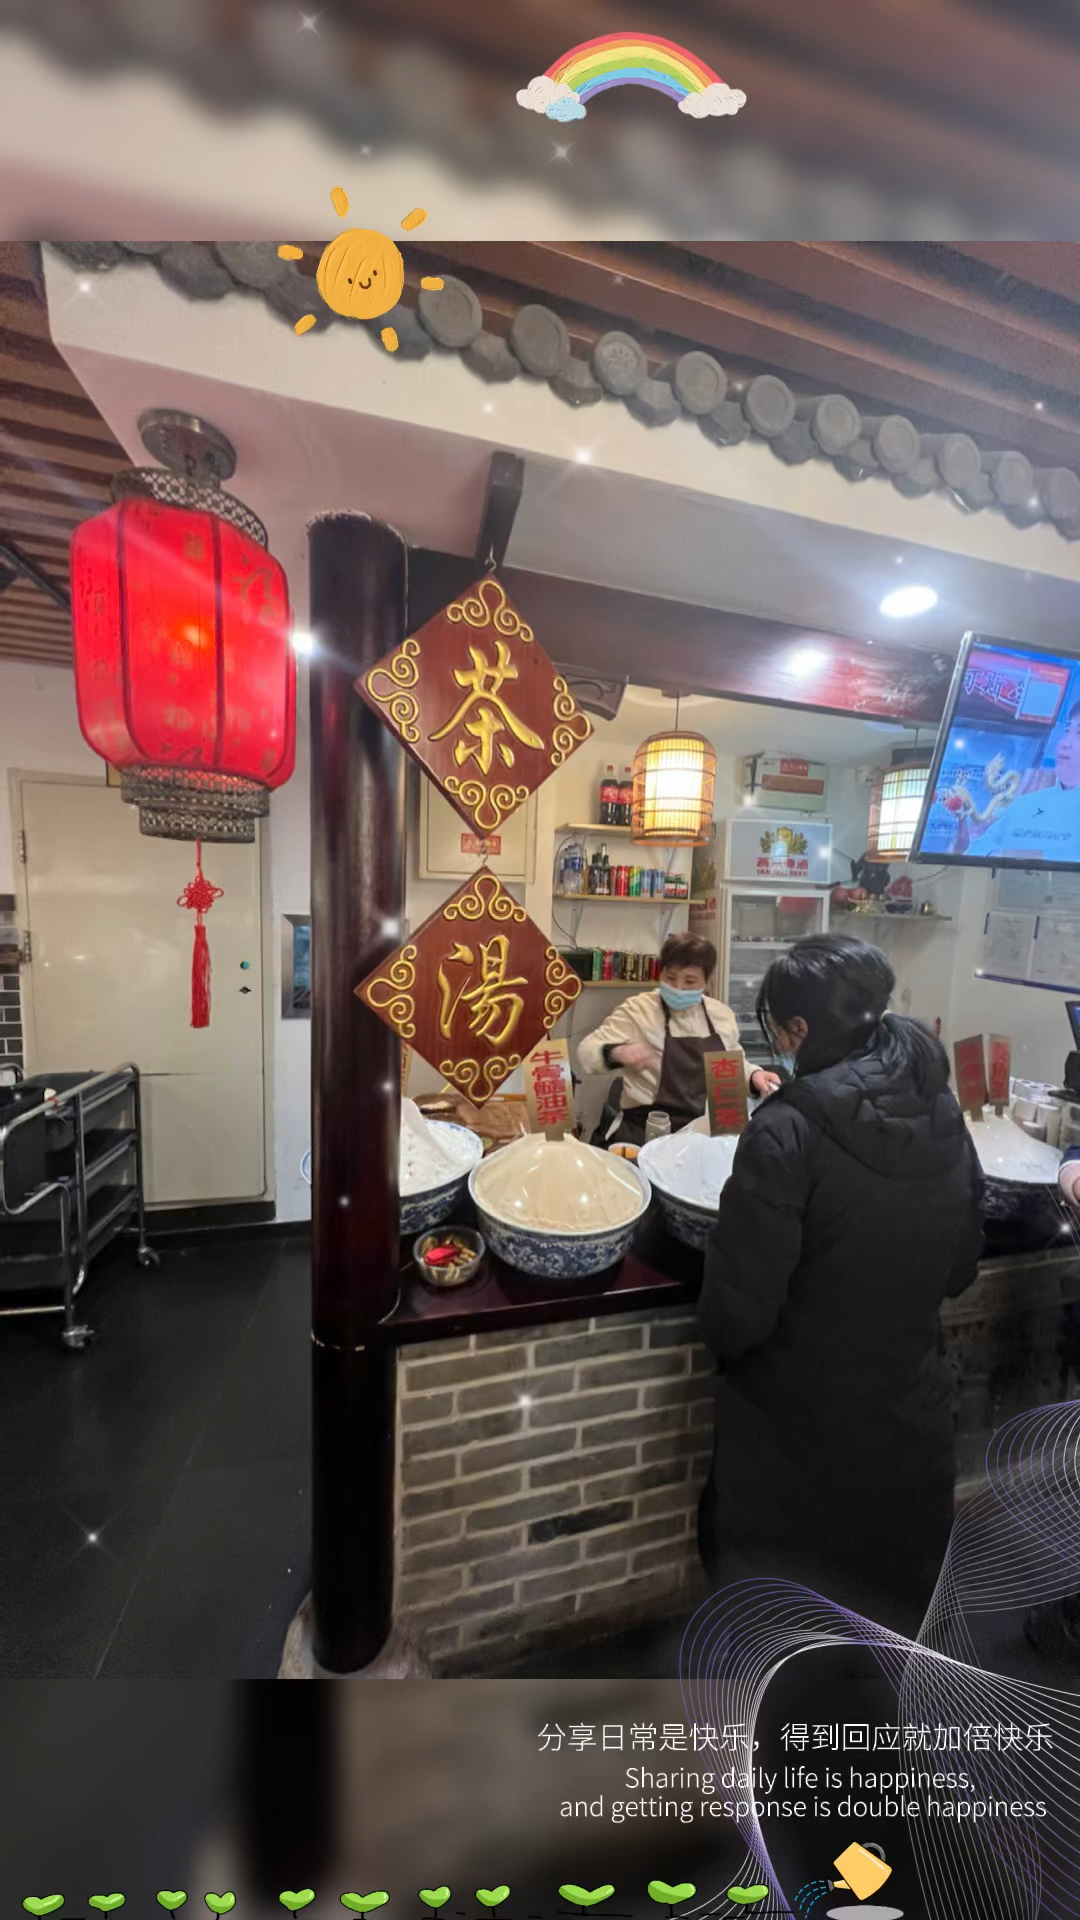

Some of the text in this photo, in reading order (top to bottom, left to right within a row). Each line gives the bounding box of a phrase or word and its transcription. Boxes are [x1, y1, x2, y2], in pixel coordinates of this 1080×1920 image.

[430, 640, 545, 776] 茶
[438, 934, 529, 1047] 湯
[711, 1057, 745, 1129] 杏仁茶
